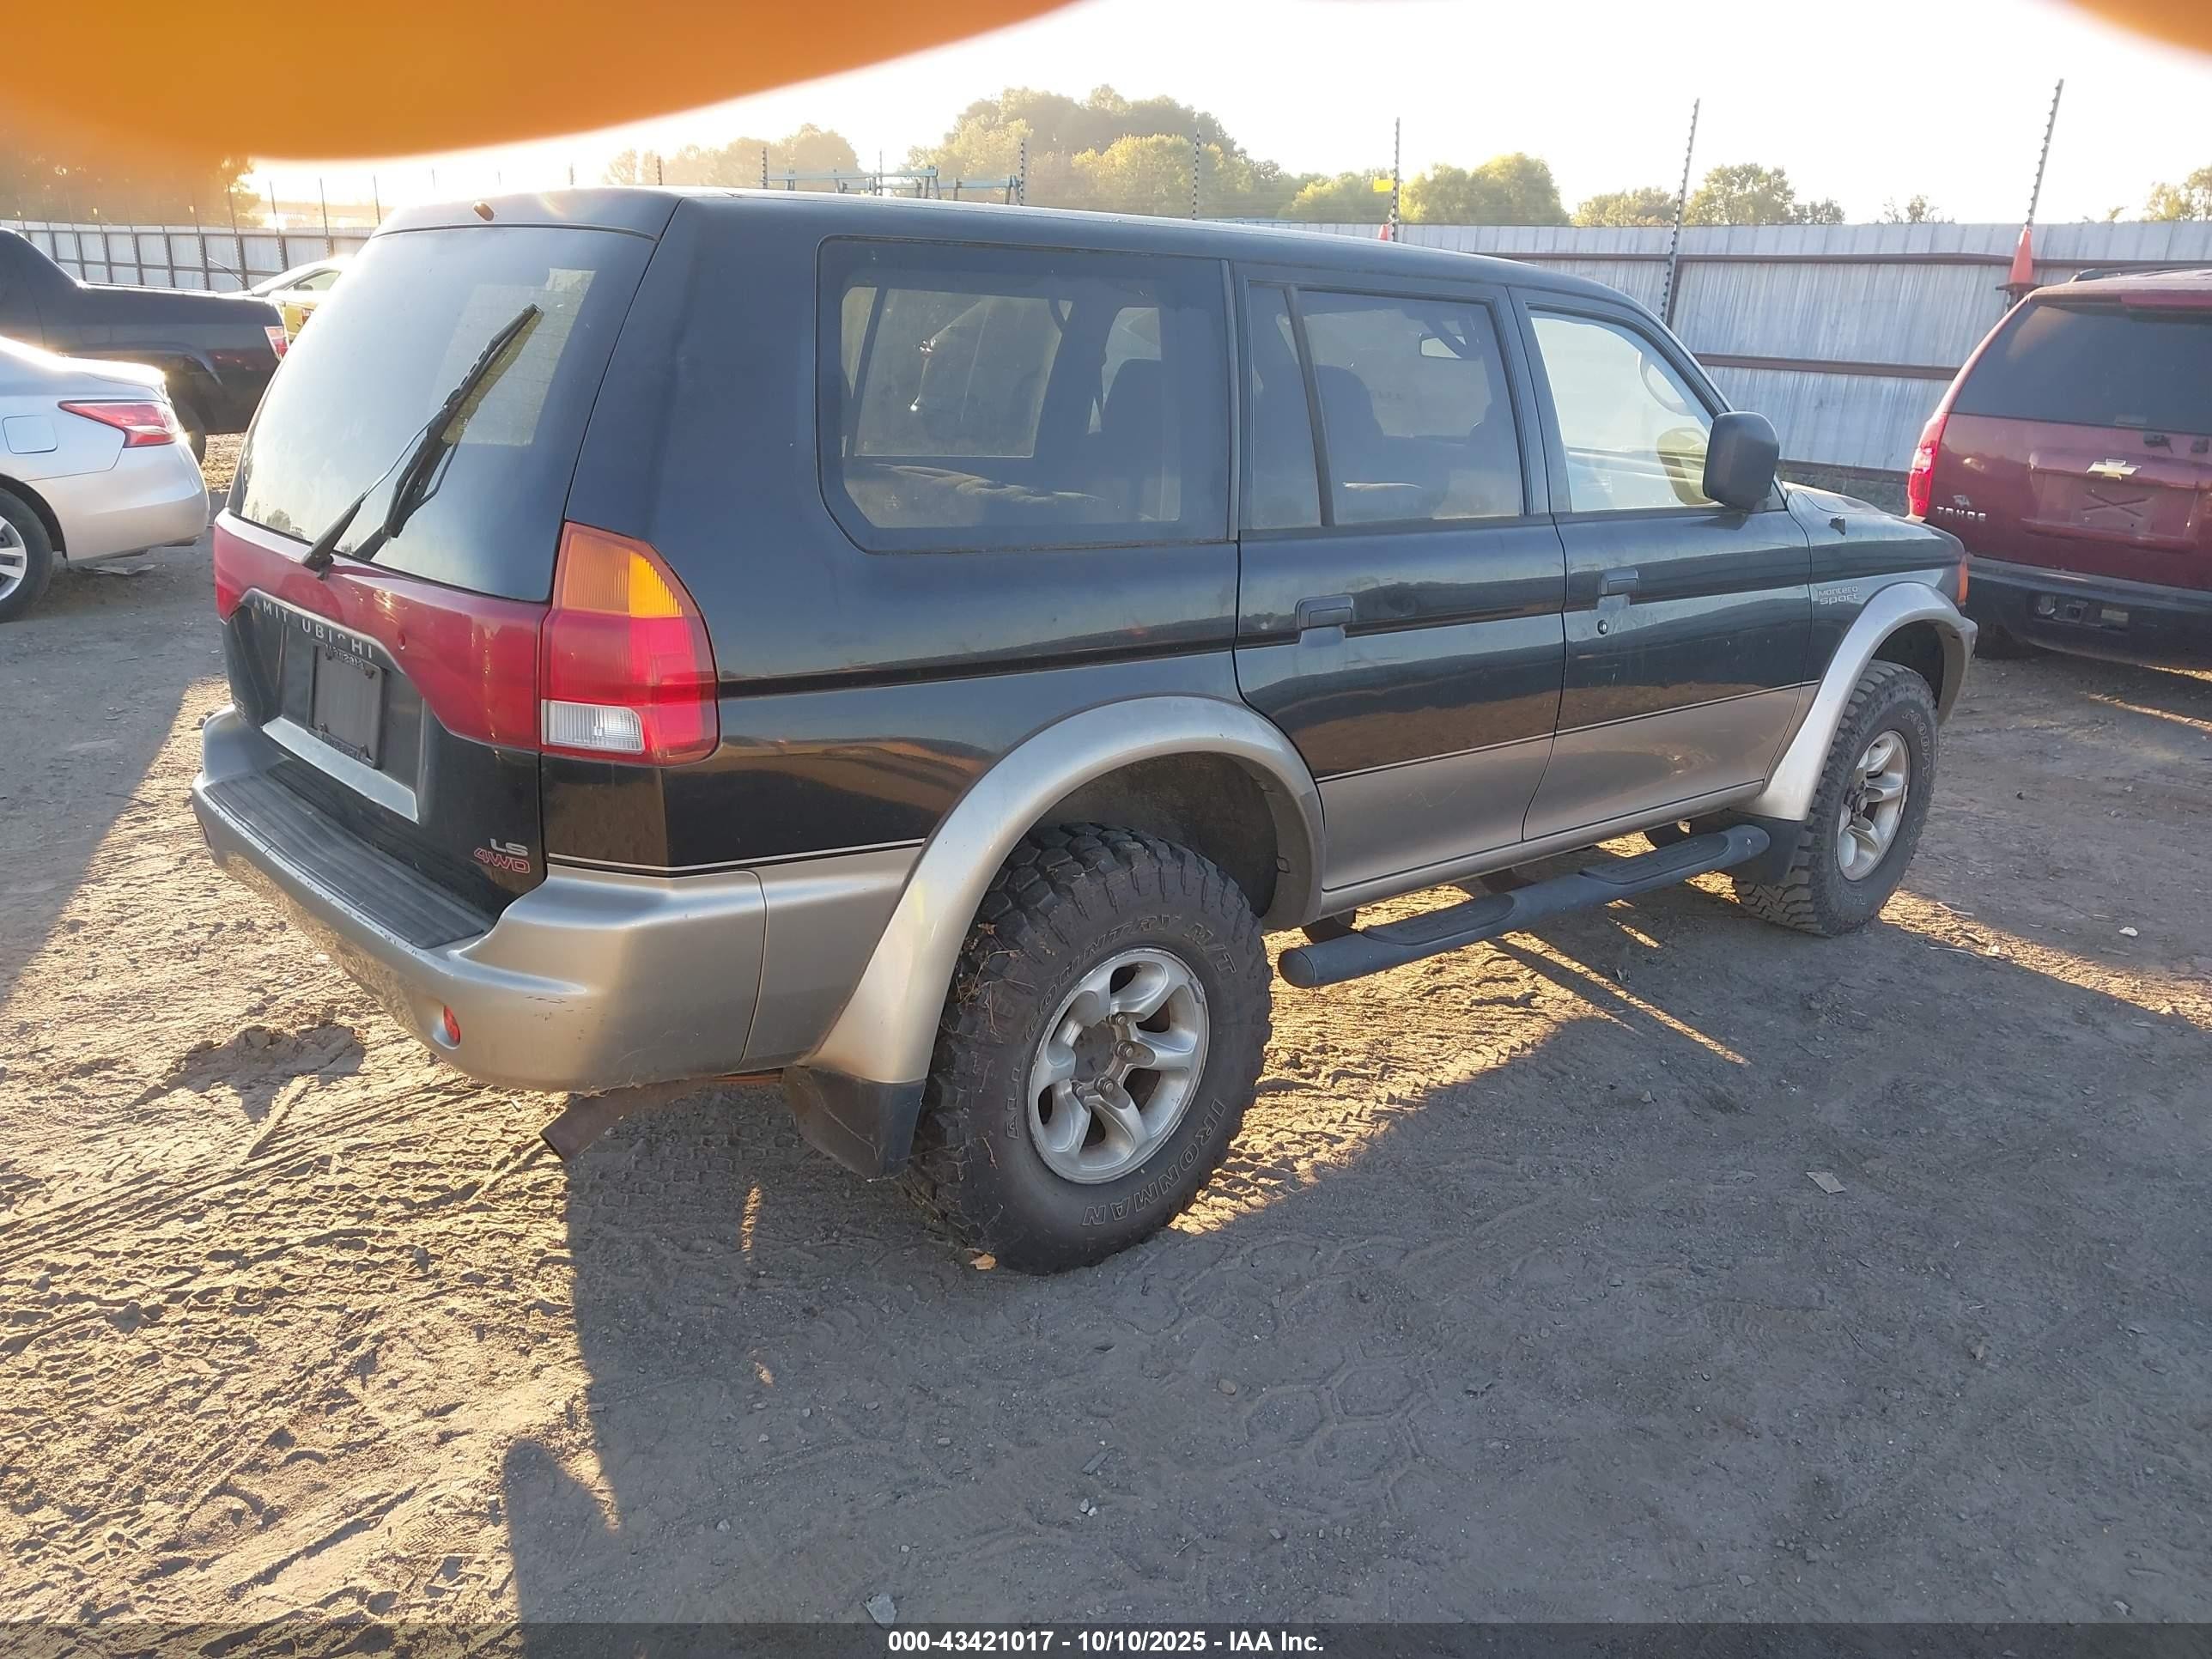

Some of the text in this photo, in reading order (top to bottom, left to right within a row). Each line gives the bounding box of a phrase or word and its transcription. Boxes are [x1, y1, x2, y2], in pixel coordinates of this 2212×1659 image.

[1936, 506, 1986, 522] TAHOE
[263, 600, 373, 659] MITUBIHI
[489, 837, 529, 857] LS
[473, 848, 531, 874] 4WD
[1081, 1097, 1226, 1226] IRONMAN
